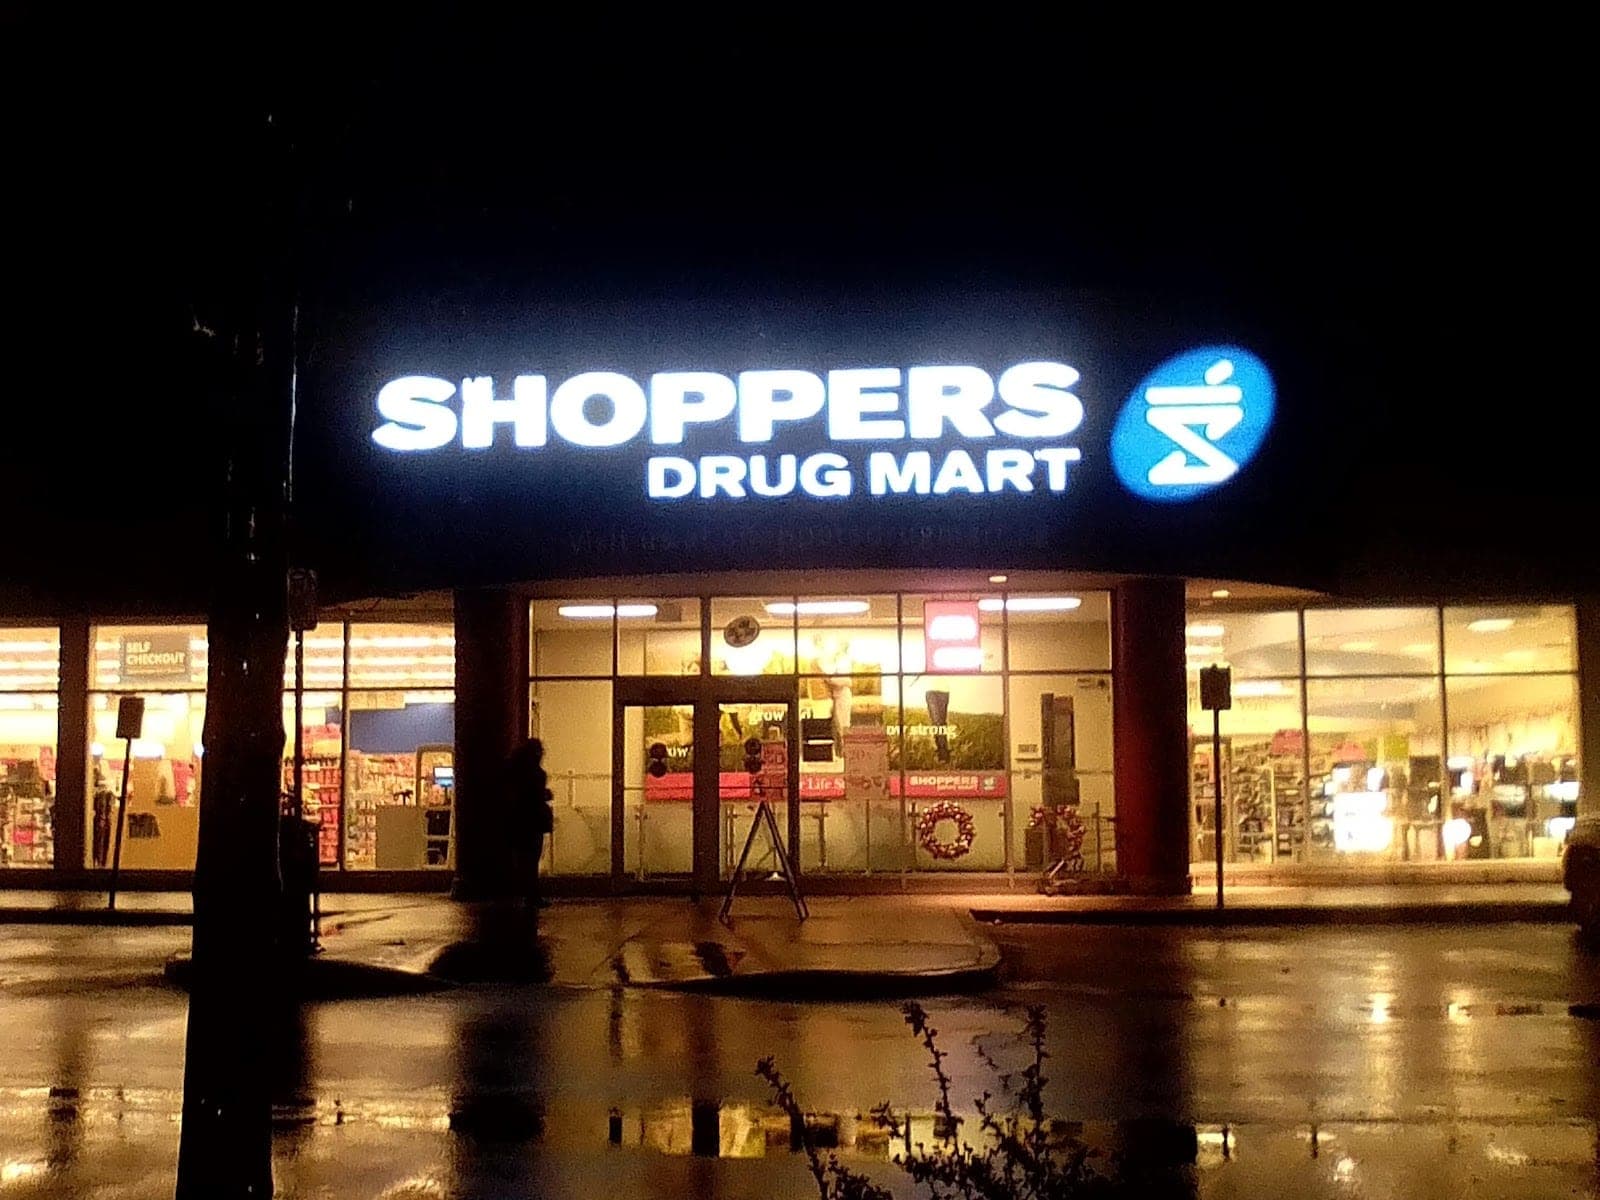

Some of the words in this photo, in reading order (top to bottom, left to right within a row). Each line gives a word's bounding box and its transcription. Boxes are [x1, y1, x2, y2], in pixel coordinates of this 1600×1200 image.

[372, 362, 1083, 450] SHOPPERS
[648, 453, 852, 498] DRUG
[869, 447, 1081, 495] MART
[126, 651, 186, 665] CHECKOUT
